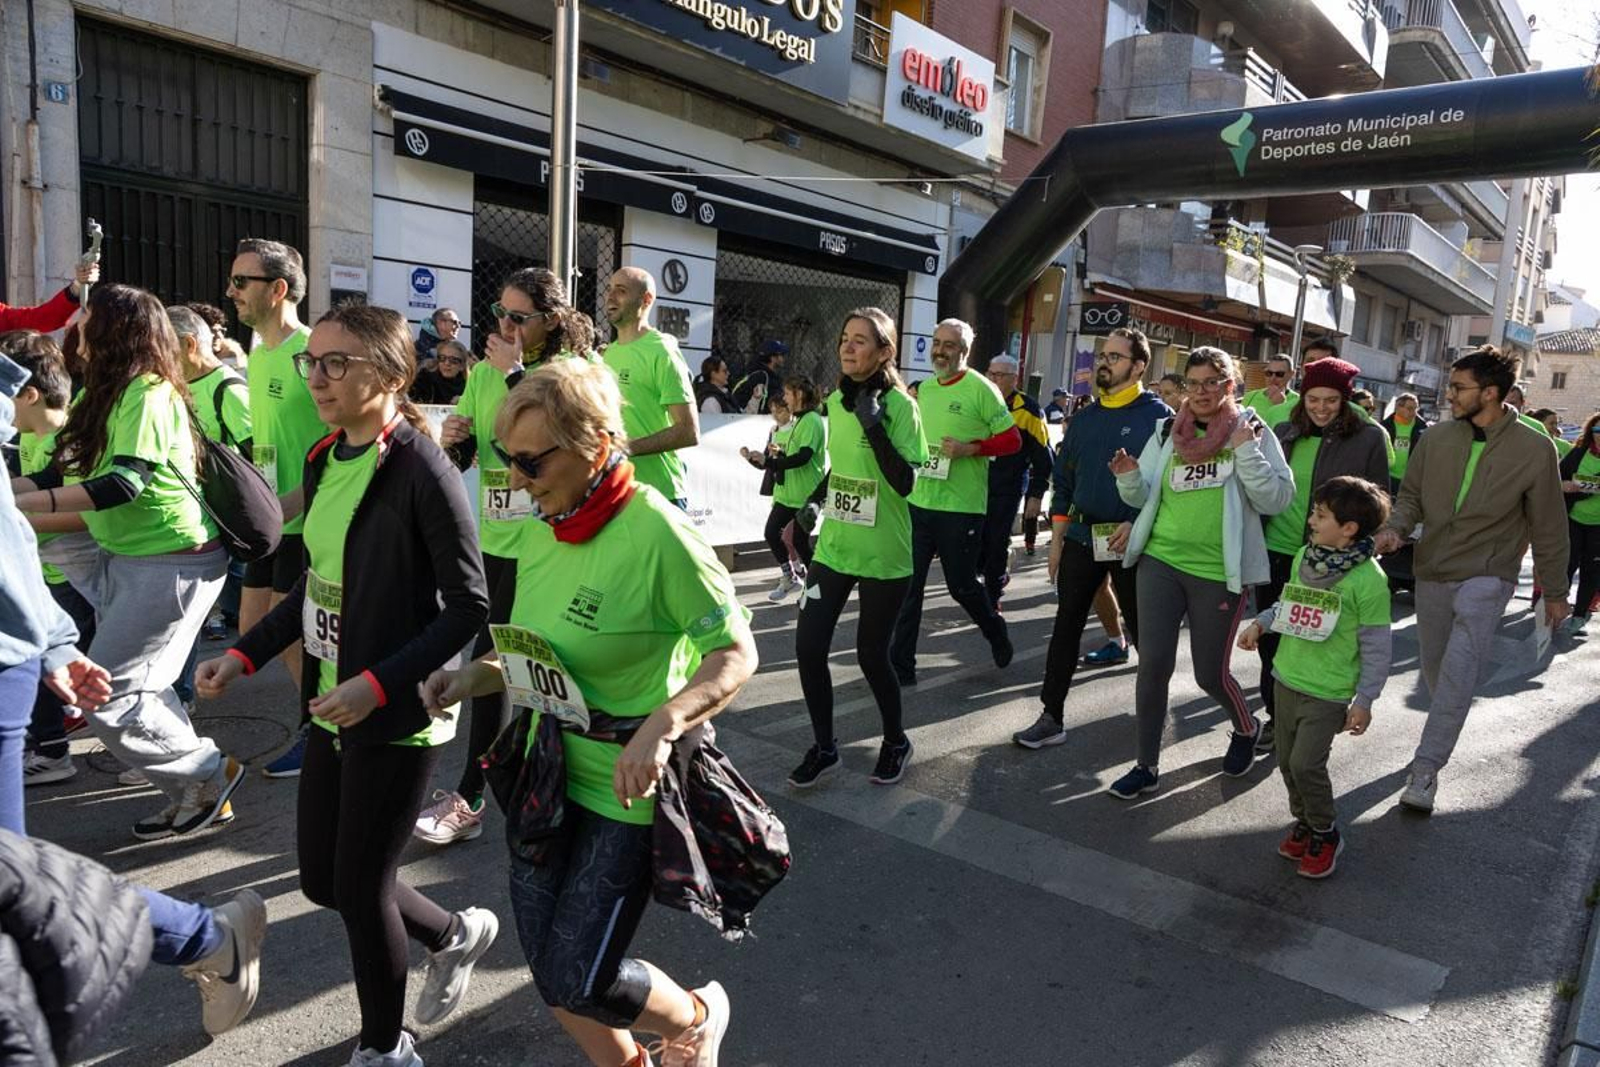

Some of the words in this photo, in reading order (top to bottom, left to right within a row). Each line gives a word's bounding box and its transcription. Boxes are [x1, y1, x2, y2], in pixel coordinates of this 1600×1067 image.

[756, 0, 843, 33] OS
[669, 0, 760, 38] ngulo
[762, 16, 816, 64] Legal
[52, 83, 64, 101] 6
[902, 47, 988, 112] emóleo
[901, 84, 943, 120] diseño
[943, 108, 984, 137] gráfico
[1261, 121, 1342, 142] Patronato
[1347, 109, 1434, 132] Municipal
[1440, 107, 1465, 122] de
[1260, 141, 1336, 161] Deportes
[1340, 138, 1363, 152] de
[1367, 132, 1412, 150] Jaén
[820, 231, 847, 254] PASOS
[1184, 462, 1217, 482] 294
[488, 488, 511, 509] 157
[835, 492, 861, 513] 862
[1289, 604, 1324, 629] 955
[526, 659, 568, 701] 100
